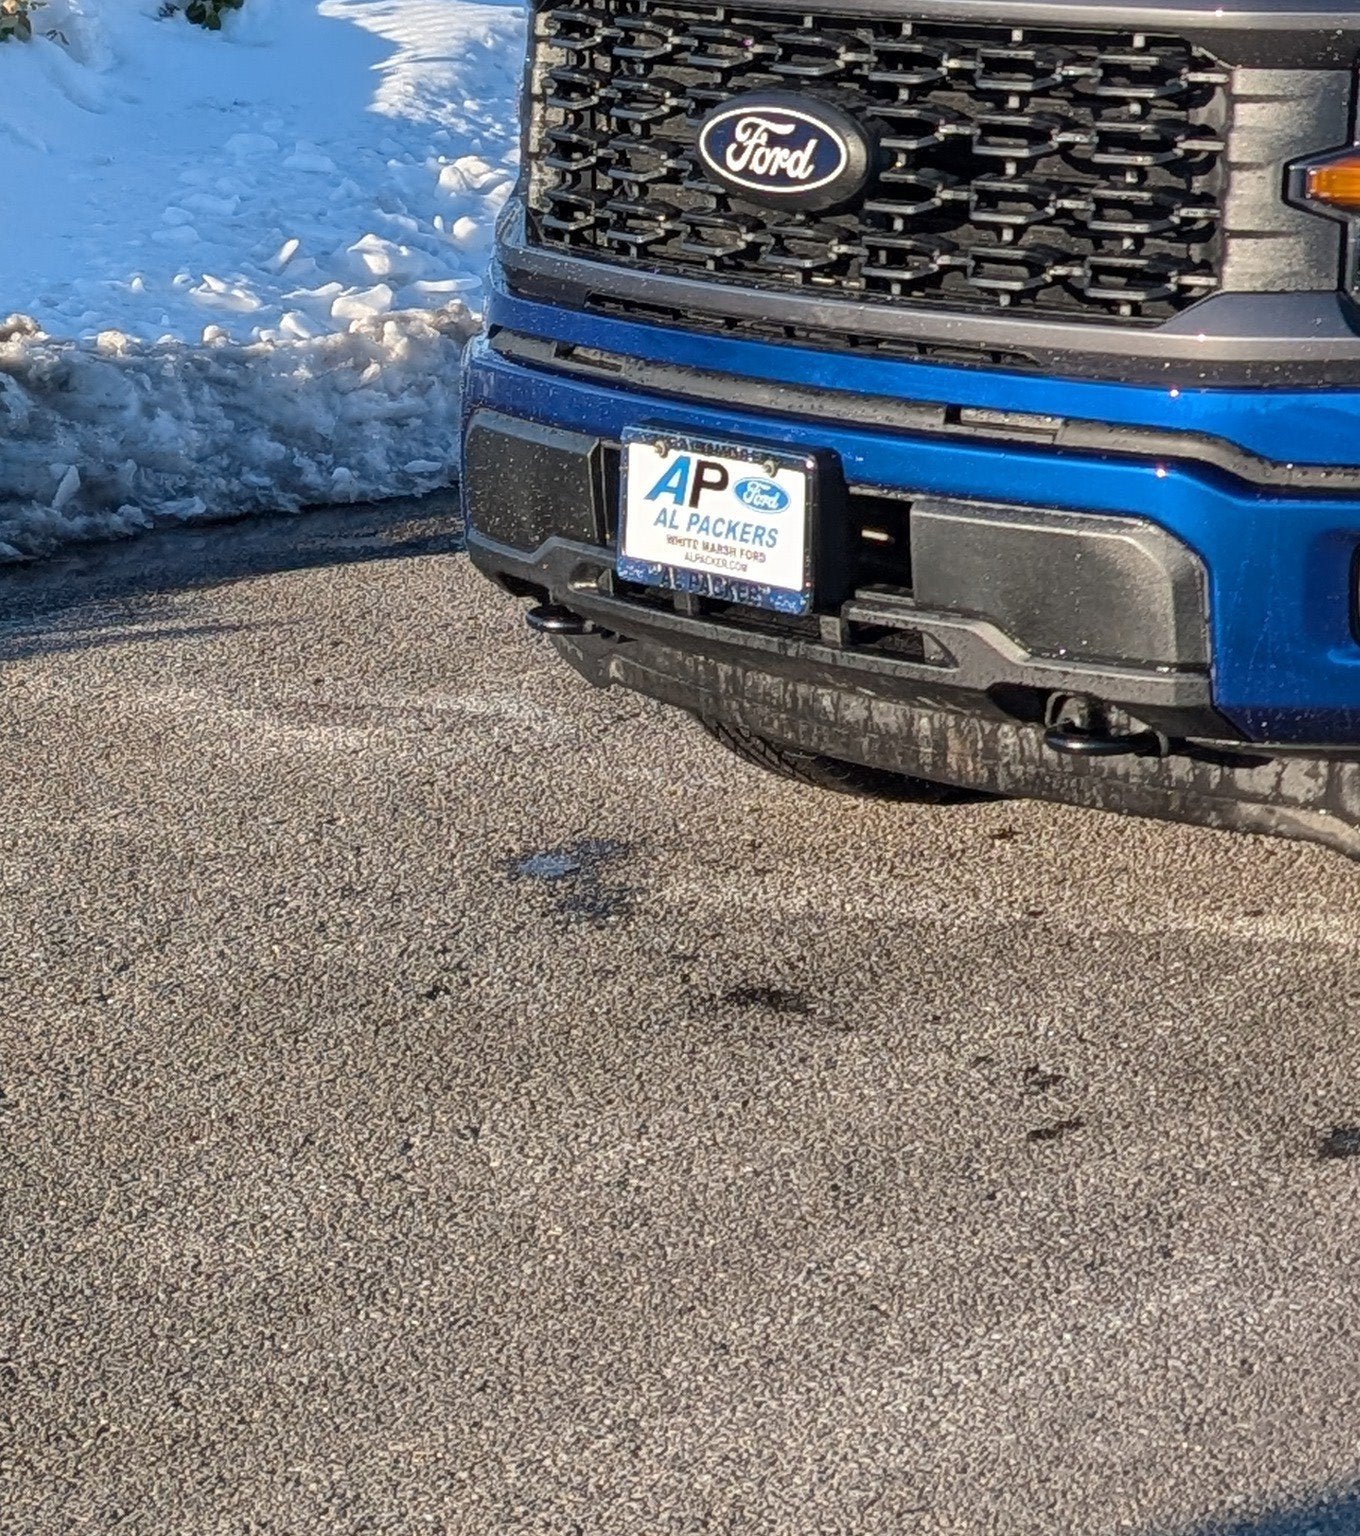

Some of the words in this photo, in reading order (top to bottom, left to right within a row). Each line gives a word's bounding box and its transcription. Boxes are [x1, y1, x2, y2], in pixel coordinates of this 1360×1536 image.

[726, 116, 819, 180] Ford
[643, 455, 730, 509] AP
[742, 481, 780, 510] Ford
[653, 507, 680, 531] AL
[685, 512, 779, 549] PACKERS
[666, 534, 699, 551] WHITE
[702, 540, 737, 557] MARSH
[740, 547, 767, 564] FORD
